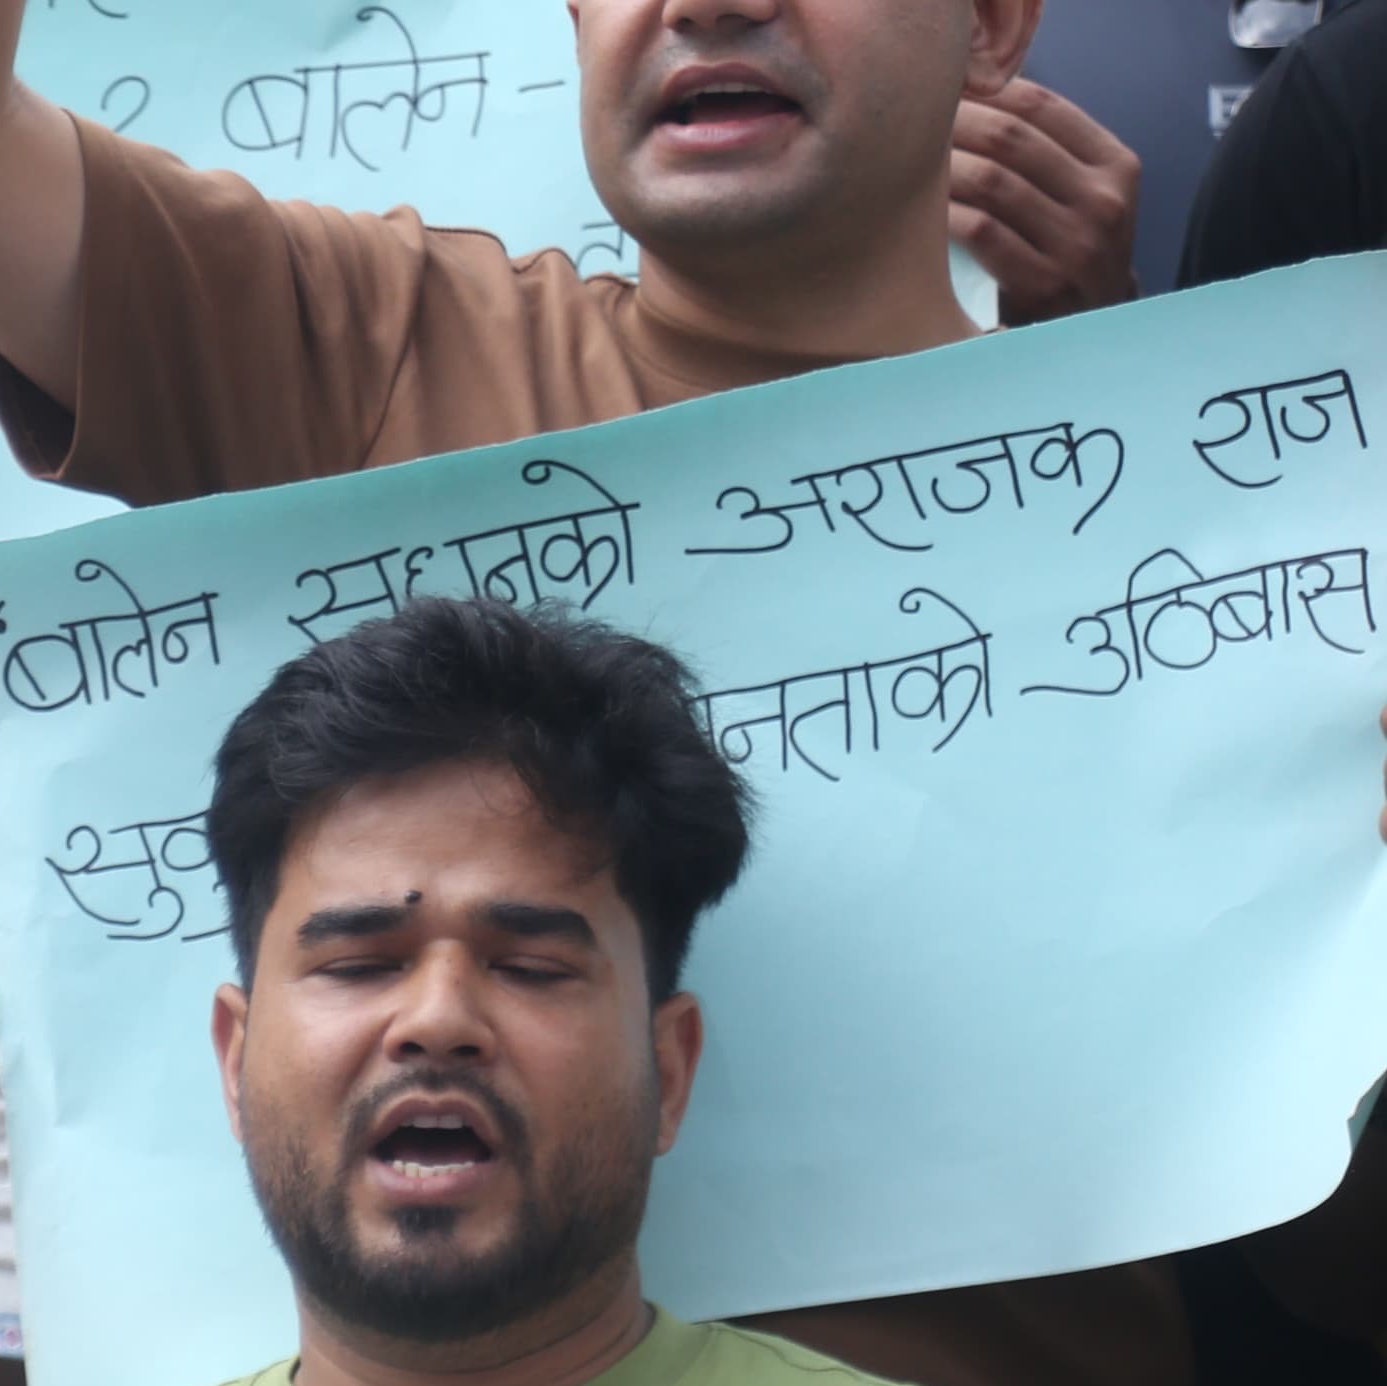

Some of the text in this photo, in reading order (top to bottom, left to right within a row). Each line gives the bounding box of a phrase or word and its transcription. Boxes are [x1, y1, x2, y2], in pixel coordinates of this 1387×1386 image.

[223, 6, 490, 171] बालेन
[684, 421, 1124, 553] अराजक
[1193, 369, 1368, 490] राज
